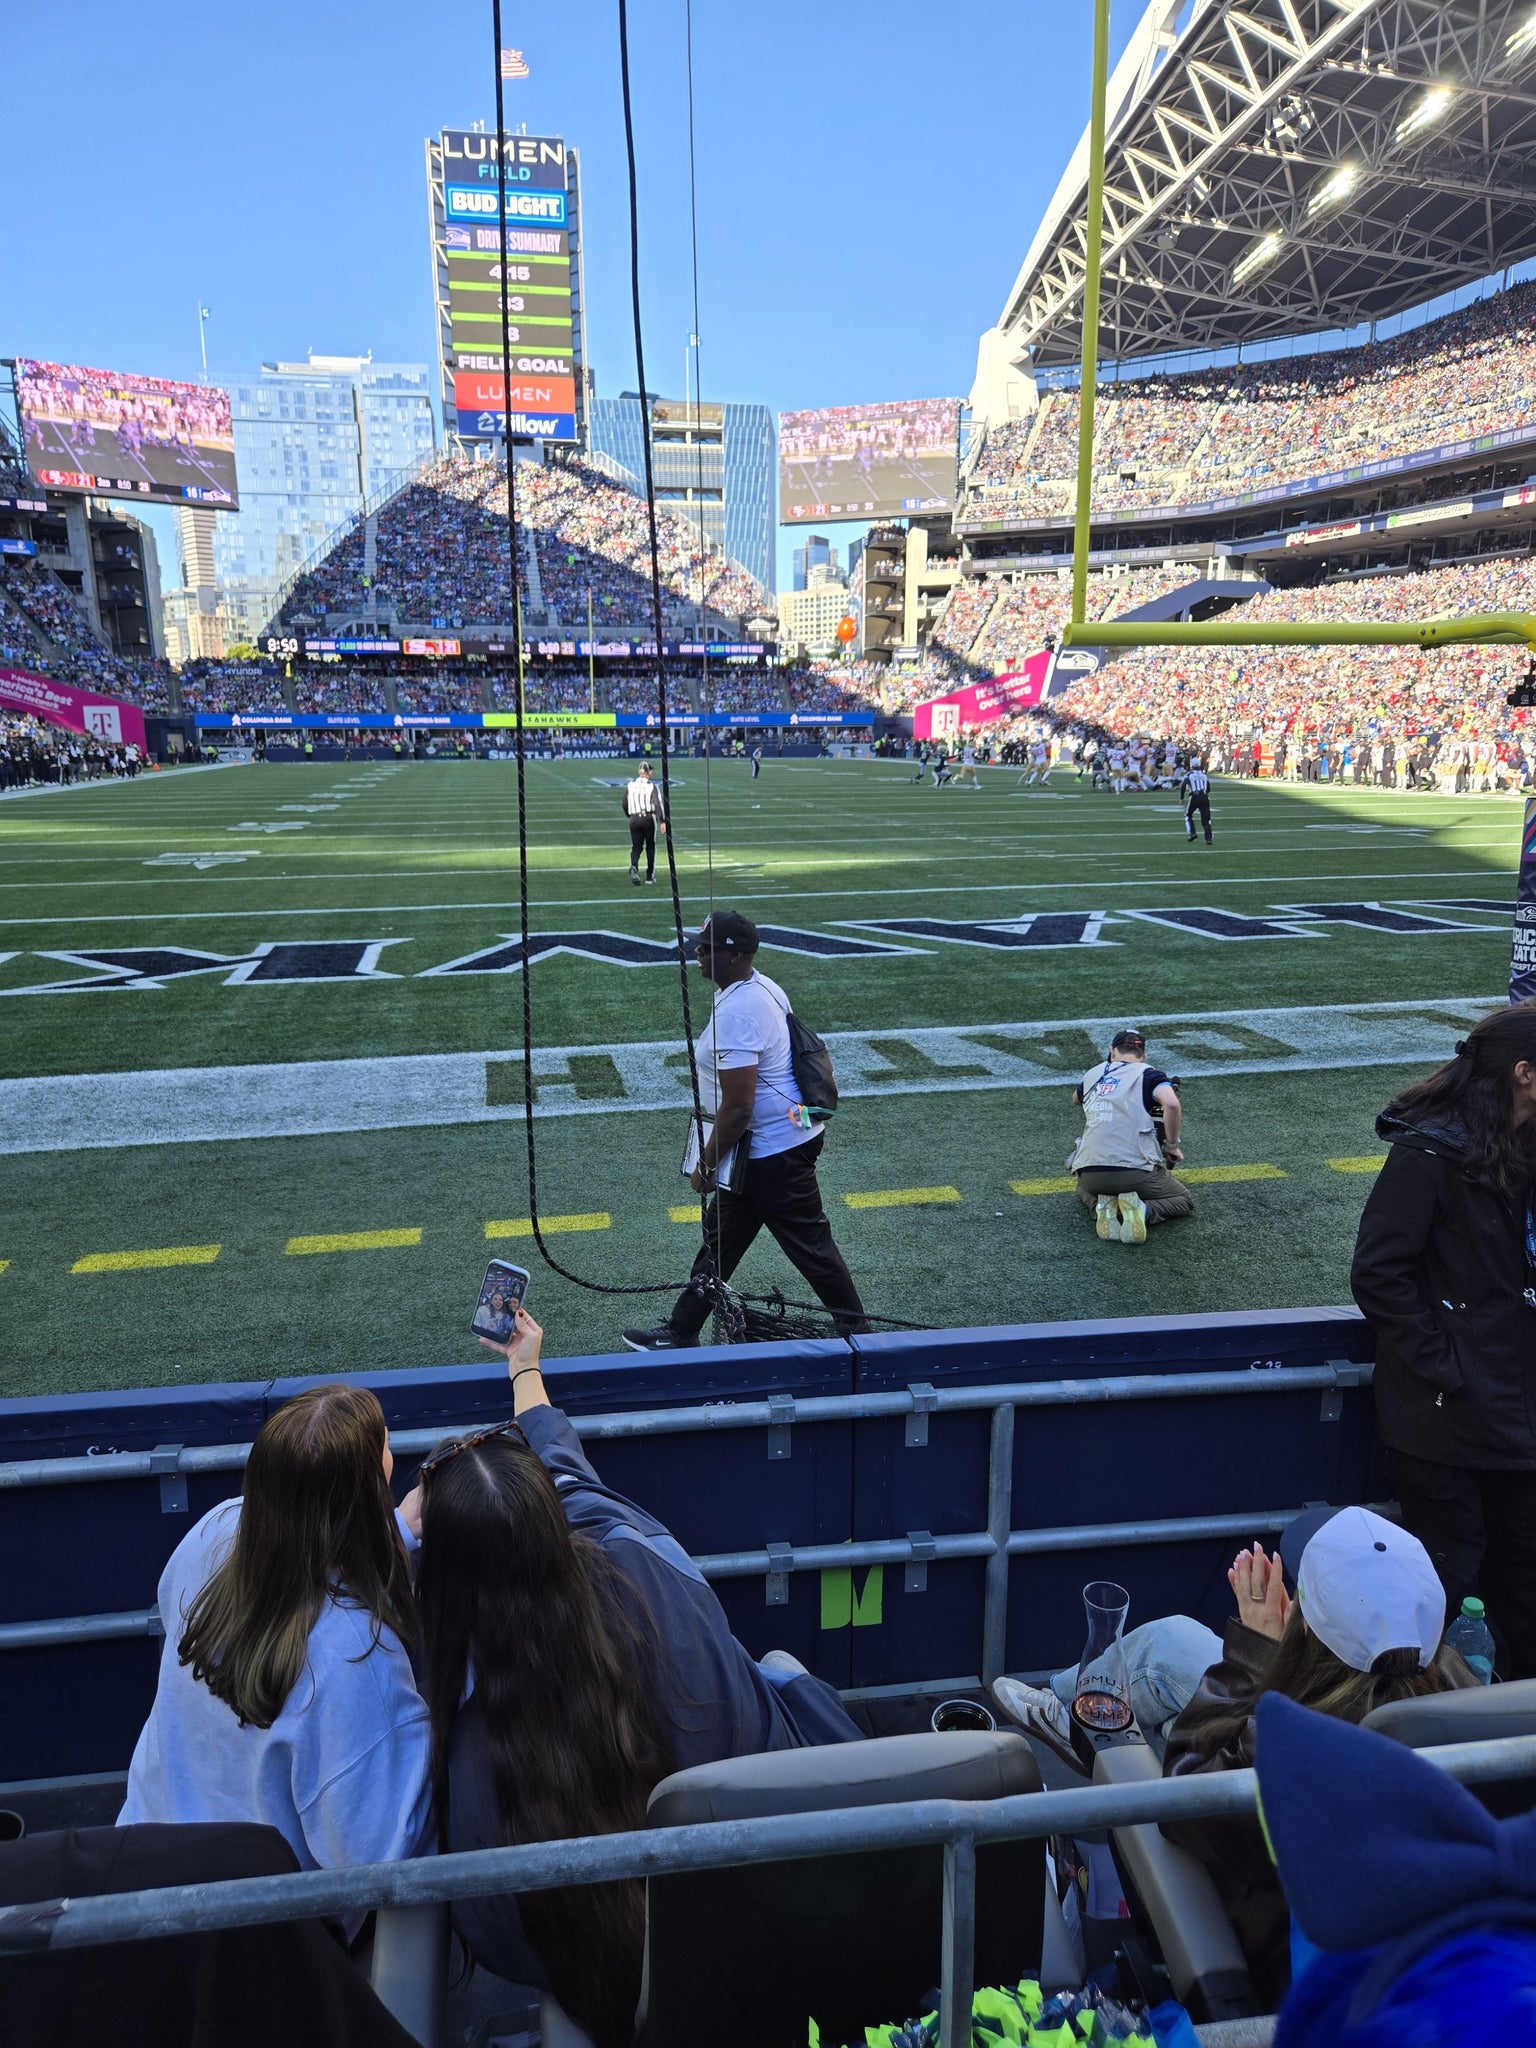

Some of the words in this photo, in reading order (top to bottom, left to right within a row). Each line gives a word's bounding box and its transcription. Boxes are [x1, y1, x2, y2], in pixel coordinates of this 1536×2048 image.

[444, 136, 563, 165] LUMEN
[478, 164, 531, 181] FILD
[452, 192, 497, 213] BUD
[477, 229, 508, 249] DRIV
[510, 231, 561, 253] SUMMARY
[489, 264, 530, 281] 415
[517, 358, 569, 374] GOAL
[476, 385, 551, 402] LUMEN
[496, 414, 559, 435] Zillow
[267, 638, 299, 652] 8:50
[224, 667, 263, 675] HYUNDAI
[975, 686, 994, 701] It's
[995, 673, 1031, 693] better
[23, 694, 60, 710] Network
[45, 690, 73, 707] Best
[979, 697, 1006, 711] over
[1006, 685, 1032, 703] here
[241, 716, 274, 724] COLUMBIA
[274, 716, 293, 724] BANK
[562, 750, 627, 759] EAHAWK
